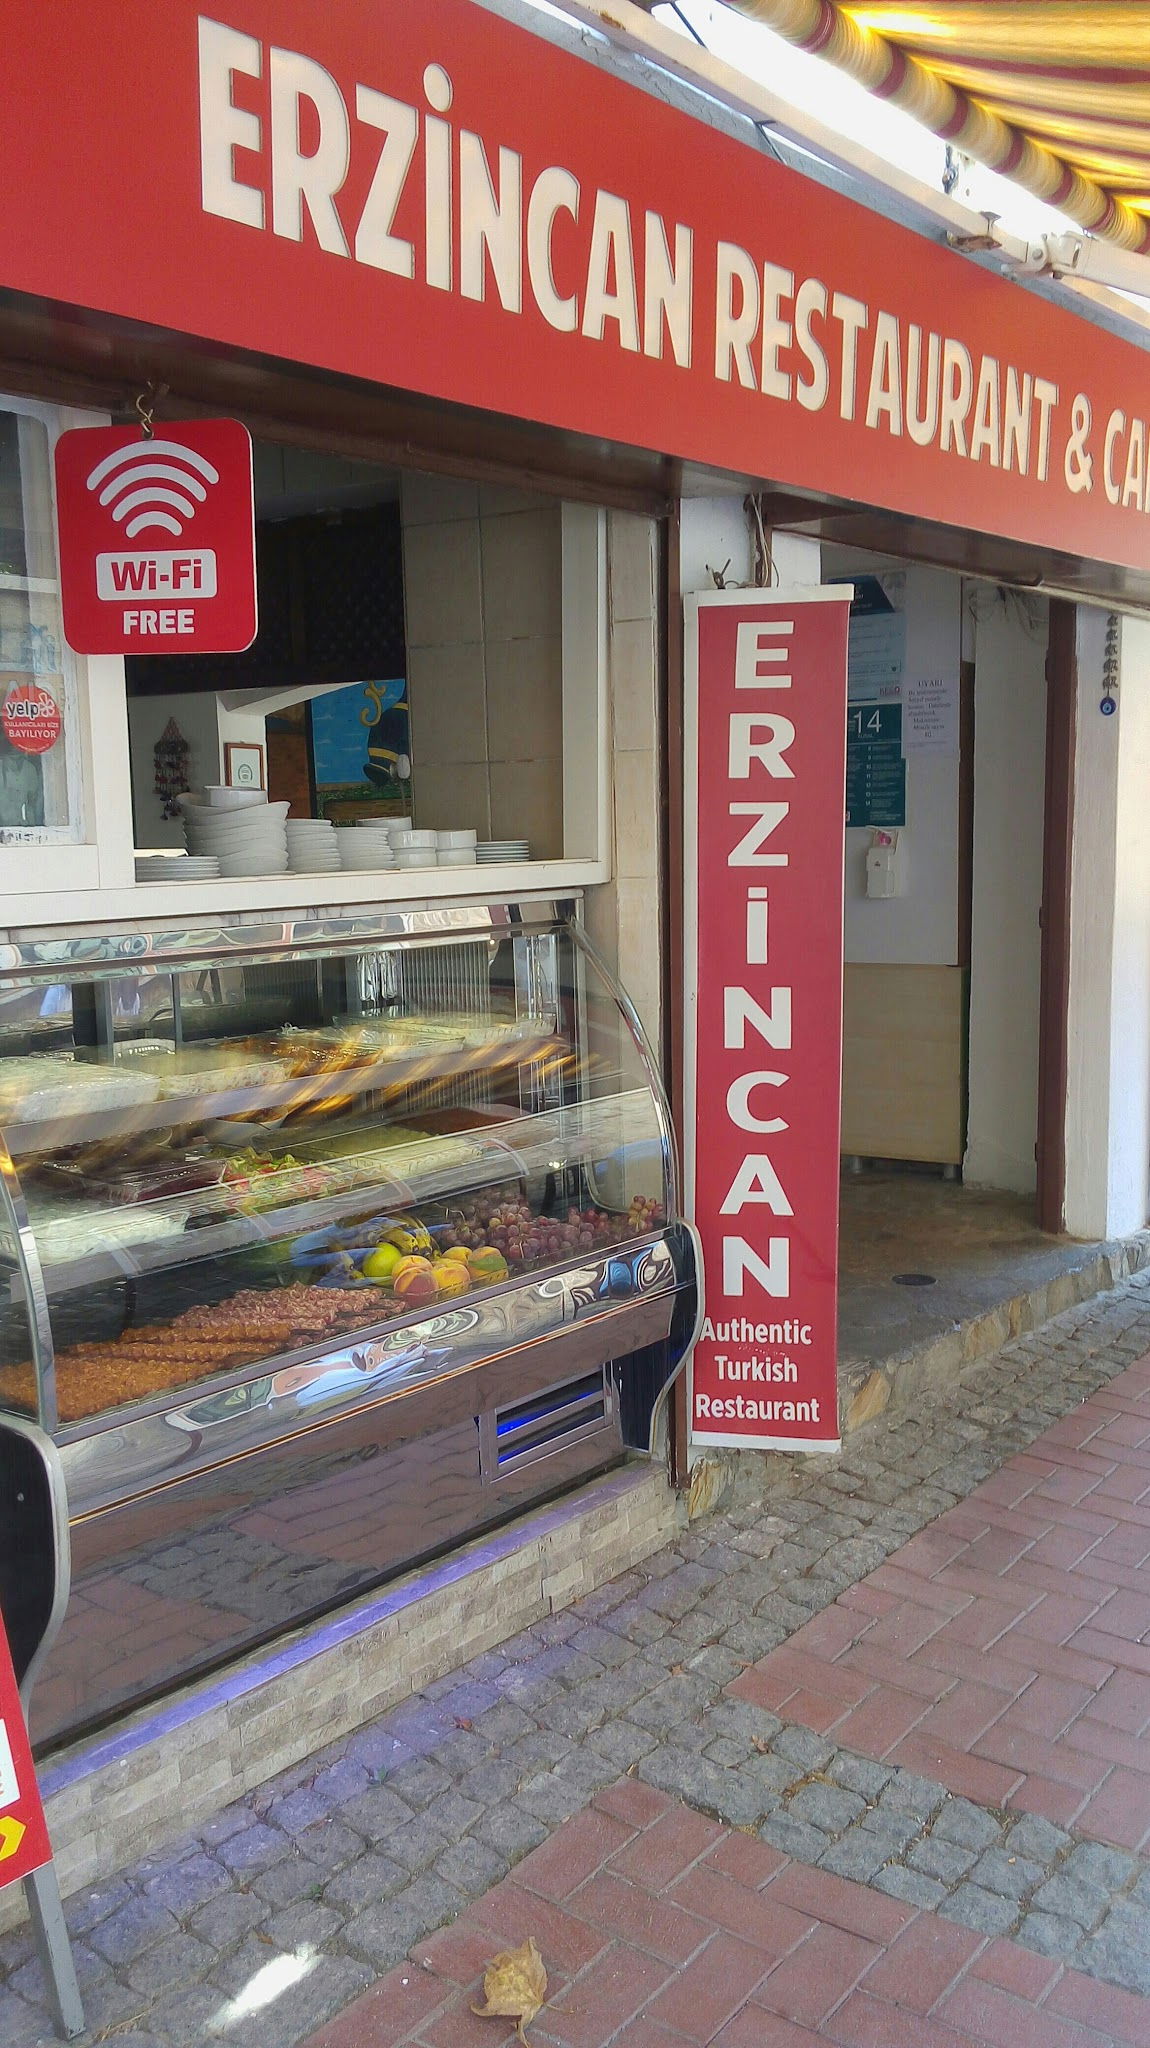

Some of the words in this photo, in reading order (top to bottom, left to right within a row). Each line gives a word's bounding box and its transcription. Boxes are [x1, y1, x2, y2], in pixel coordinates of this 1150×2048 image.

[714, 241, 1059, 482] RESTAURANT
[1064, 393, 1094, 494] &
[1103, 409, 1150, 514] CA
[111, 559, 202, 591] Wi-Fi
[123, 609, 194, 635] FREE
[6, 699, 39, 720] yelp
[853, 709, 882, 734] 14
[9, 730, 56, 739] BAYILIYOR
[700, 1317, 812, 1345] Authentic
[714, 1355, 798, 1383] Turkish
[695, 1394, 820, 1422] Restaurant
